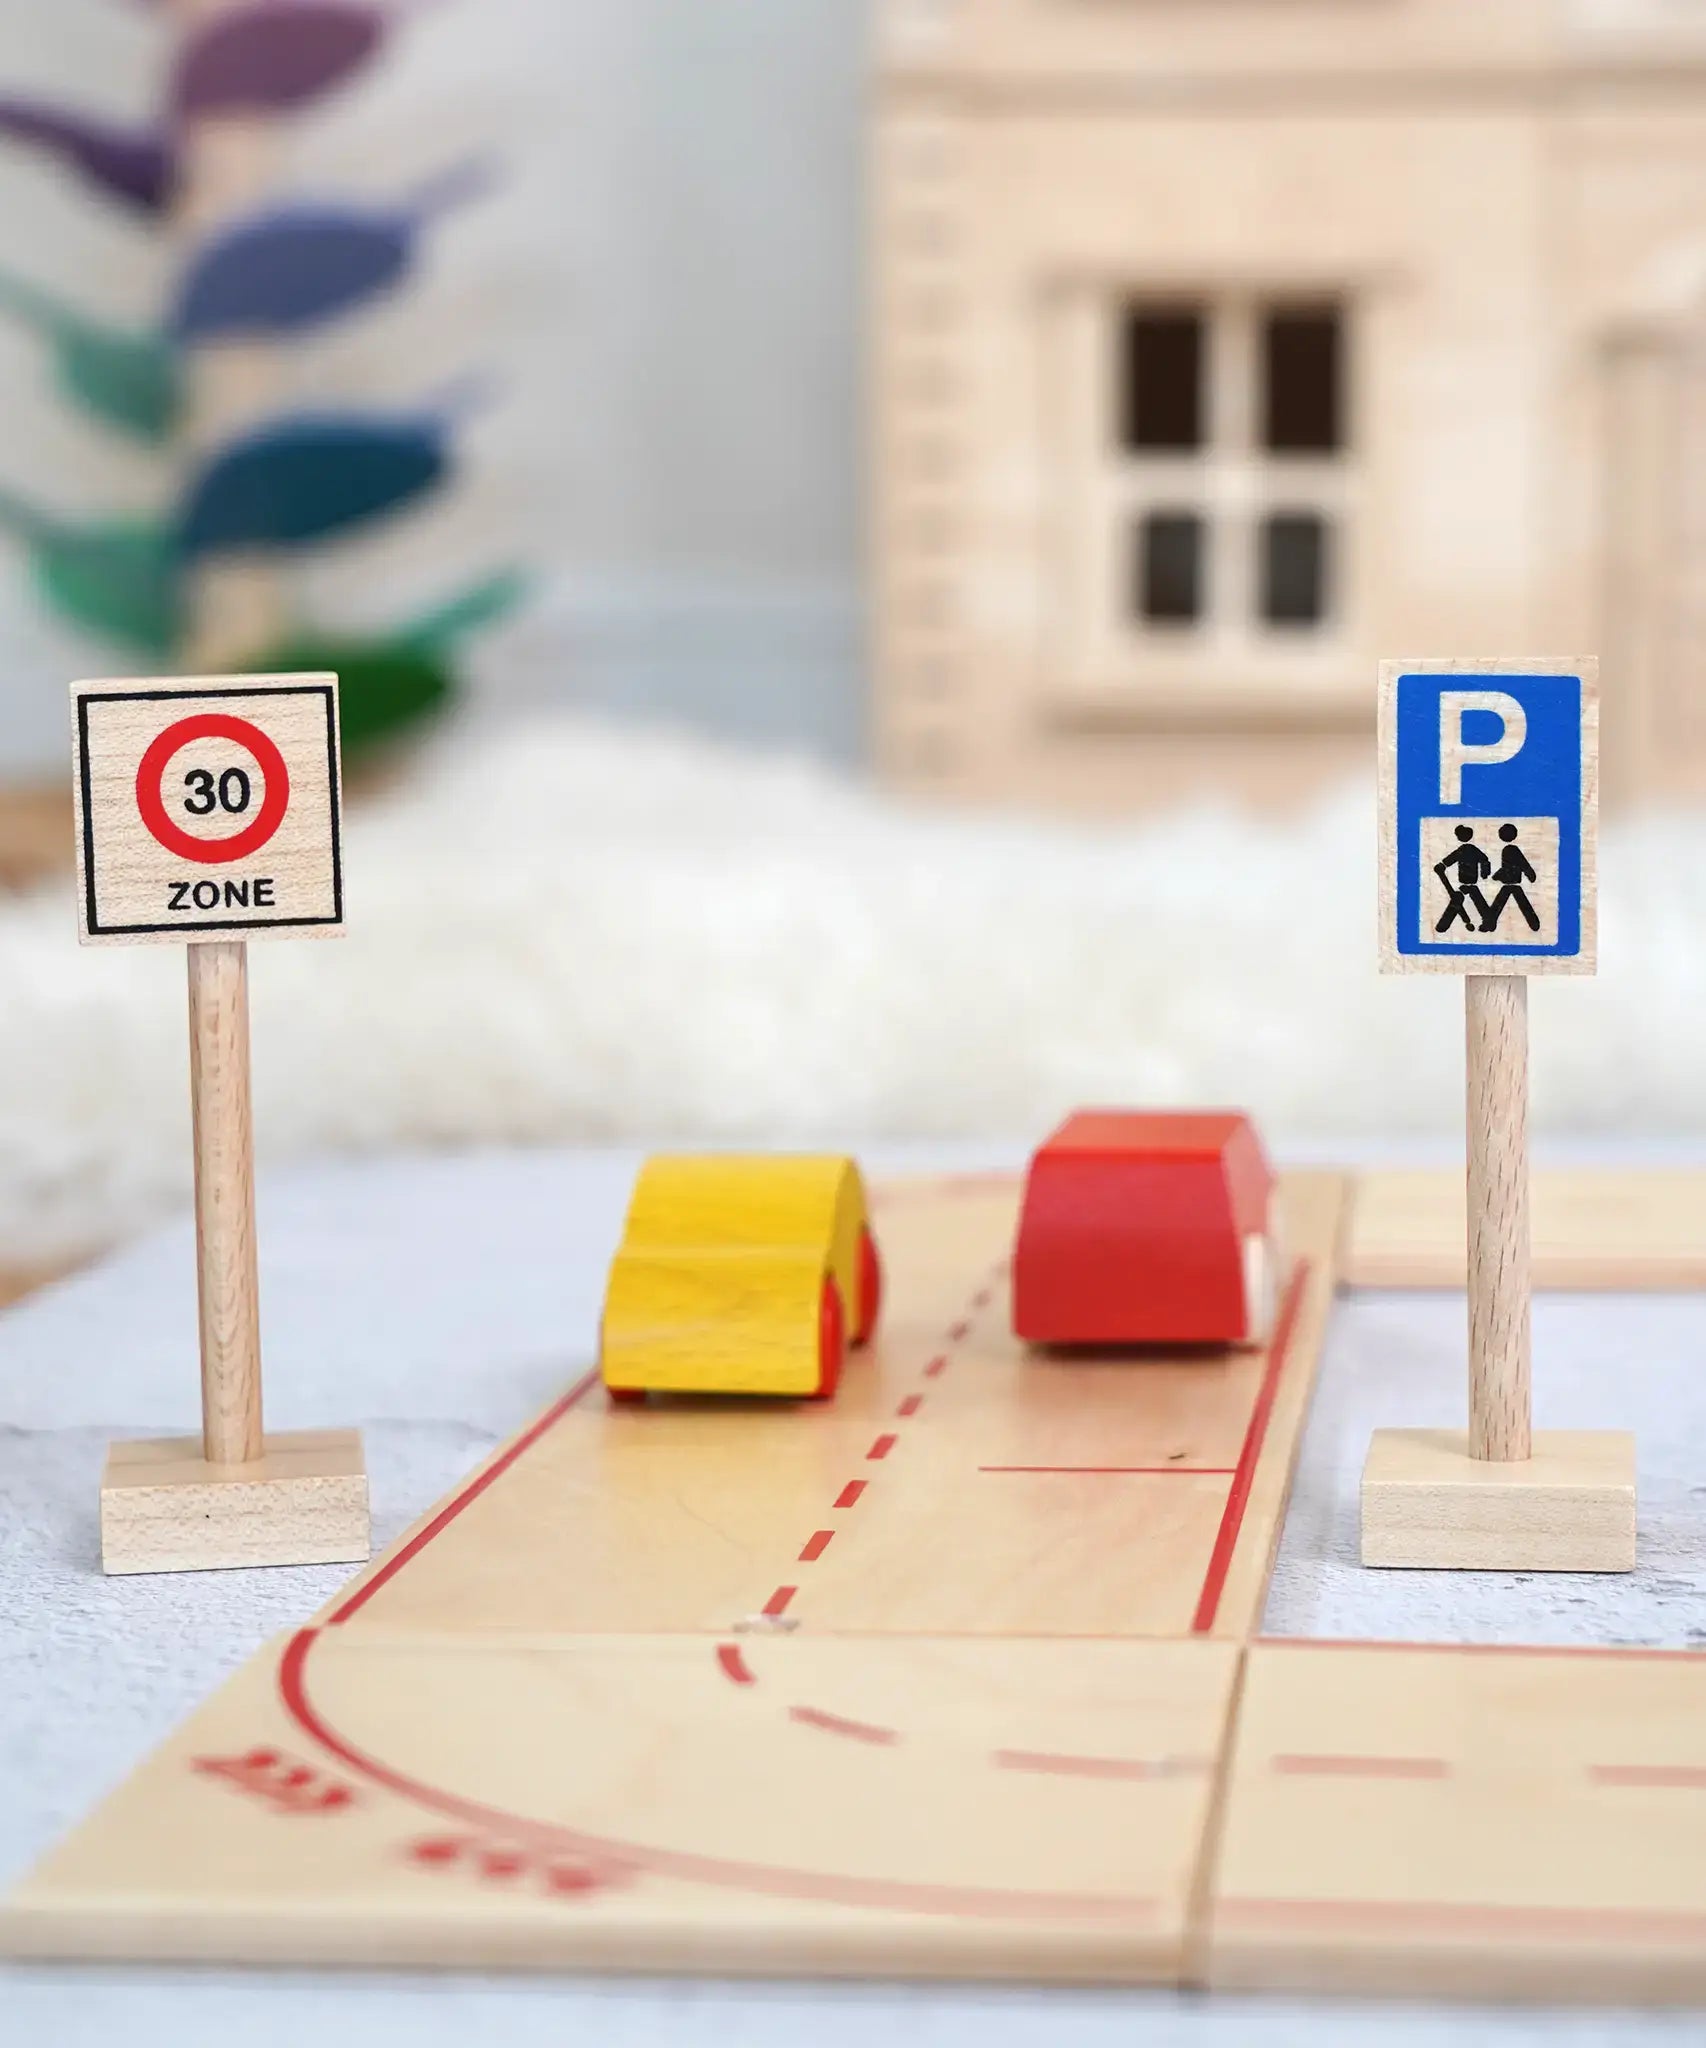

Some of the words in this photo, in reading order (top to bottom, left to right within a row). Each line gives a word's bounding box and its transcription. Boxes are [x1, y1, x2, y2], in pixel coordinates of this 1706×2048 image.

[1440, 691, 1528, 805] P
[183, 768, 251, 815] 30
[167, 879, 276, 911] ZONE
